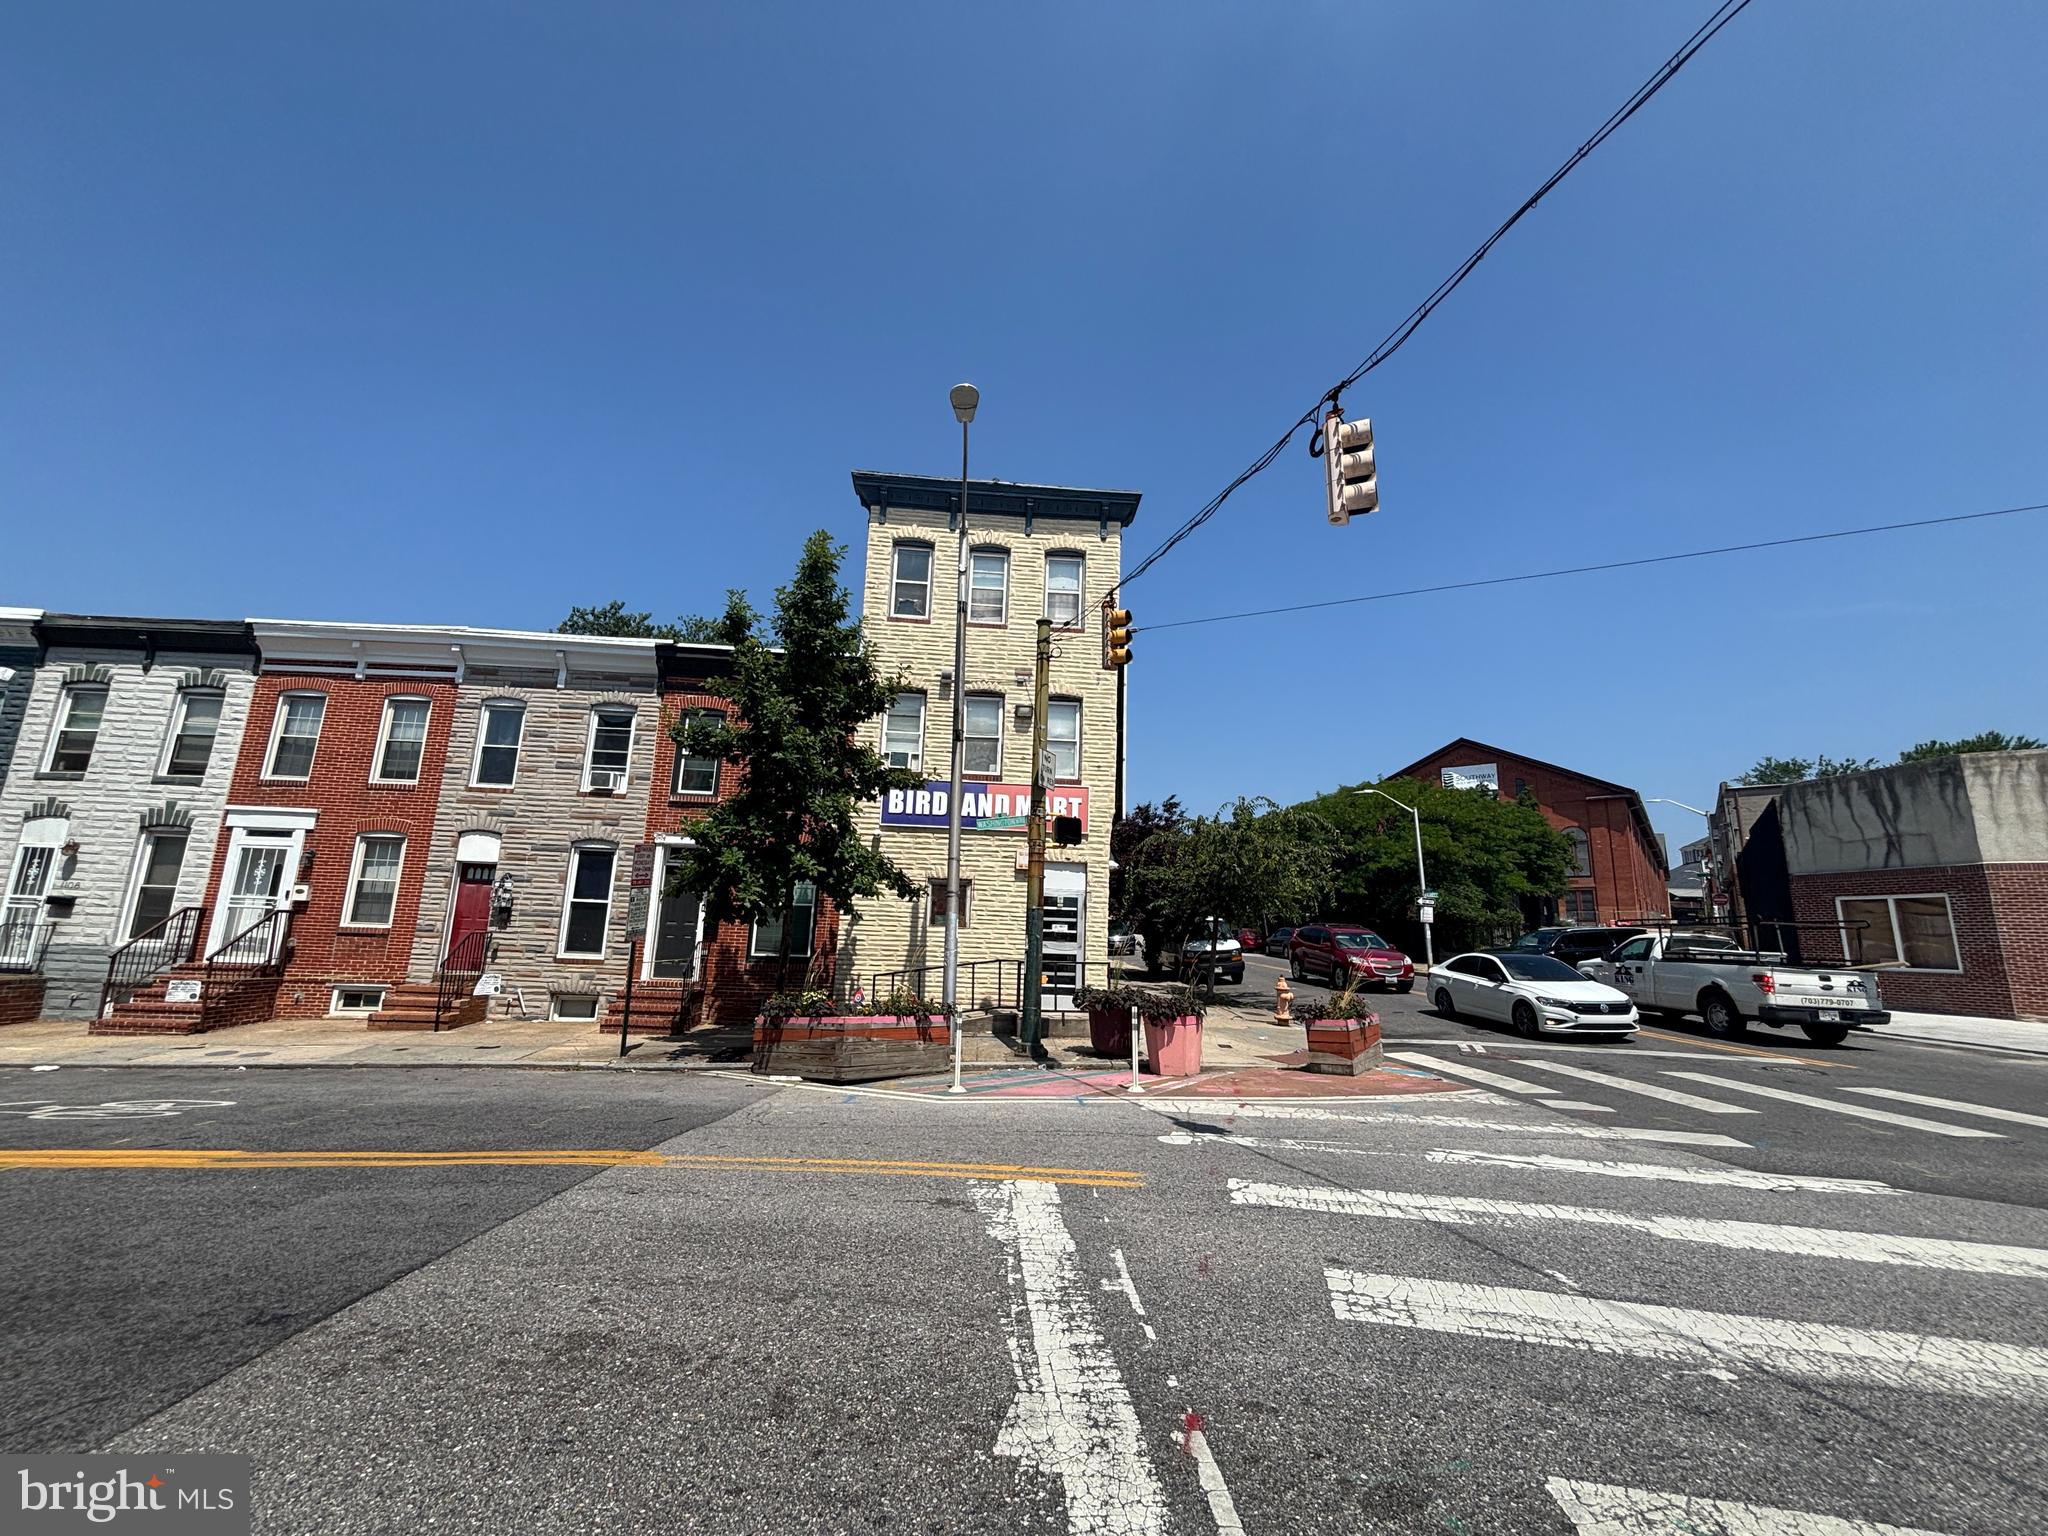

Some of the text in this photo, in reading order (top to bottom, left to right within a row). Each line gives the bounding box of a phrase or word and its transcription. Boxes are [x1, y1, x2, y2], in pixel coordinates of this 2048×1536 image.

[1455, 773, 1495, 781] SOUTHWAY
[888, 789, 1010, 817] BIRDAND
[1614, 974, 1634, 984] KING
[1846, 985, 1868, 993] KING
